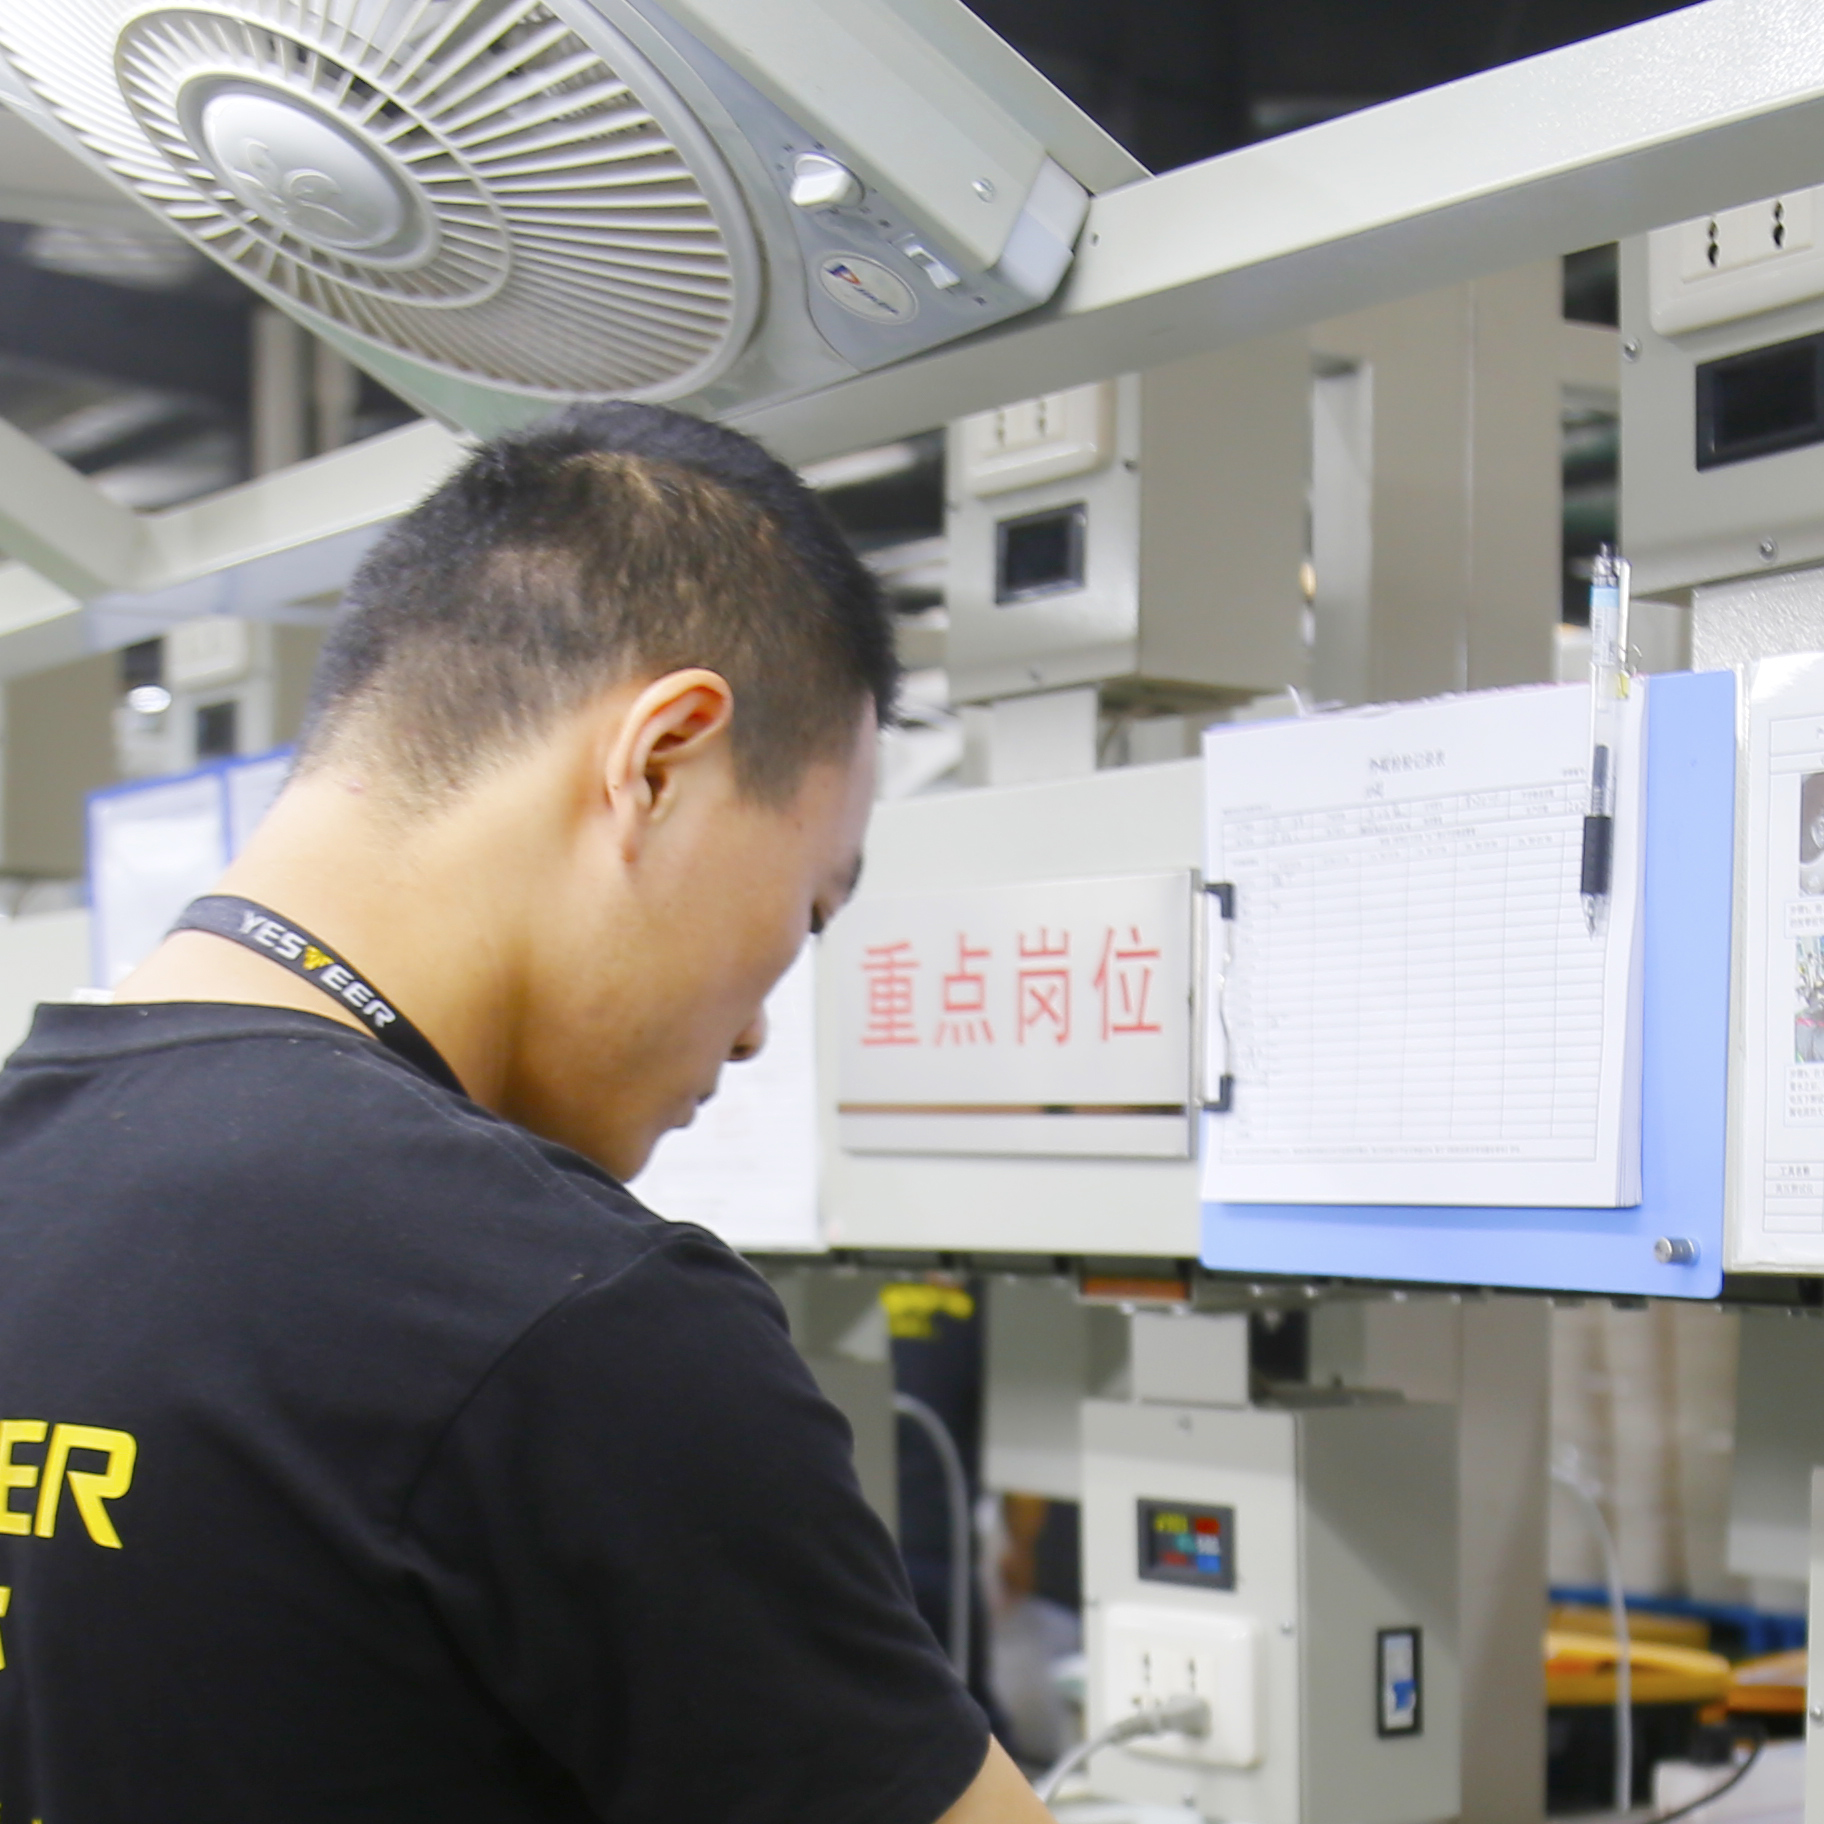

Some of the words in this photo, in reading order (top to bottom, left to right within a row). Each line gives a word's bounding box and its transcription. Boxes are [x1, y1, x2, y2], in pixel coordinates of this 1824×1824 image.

[239, 910, 396, 1028] YESVEER
[860, 925, 1162, 1047] 重点岗位
